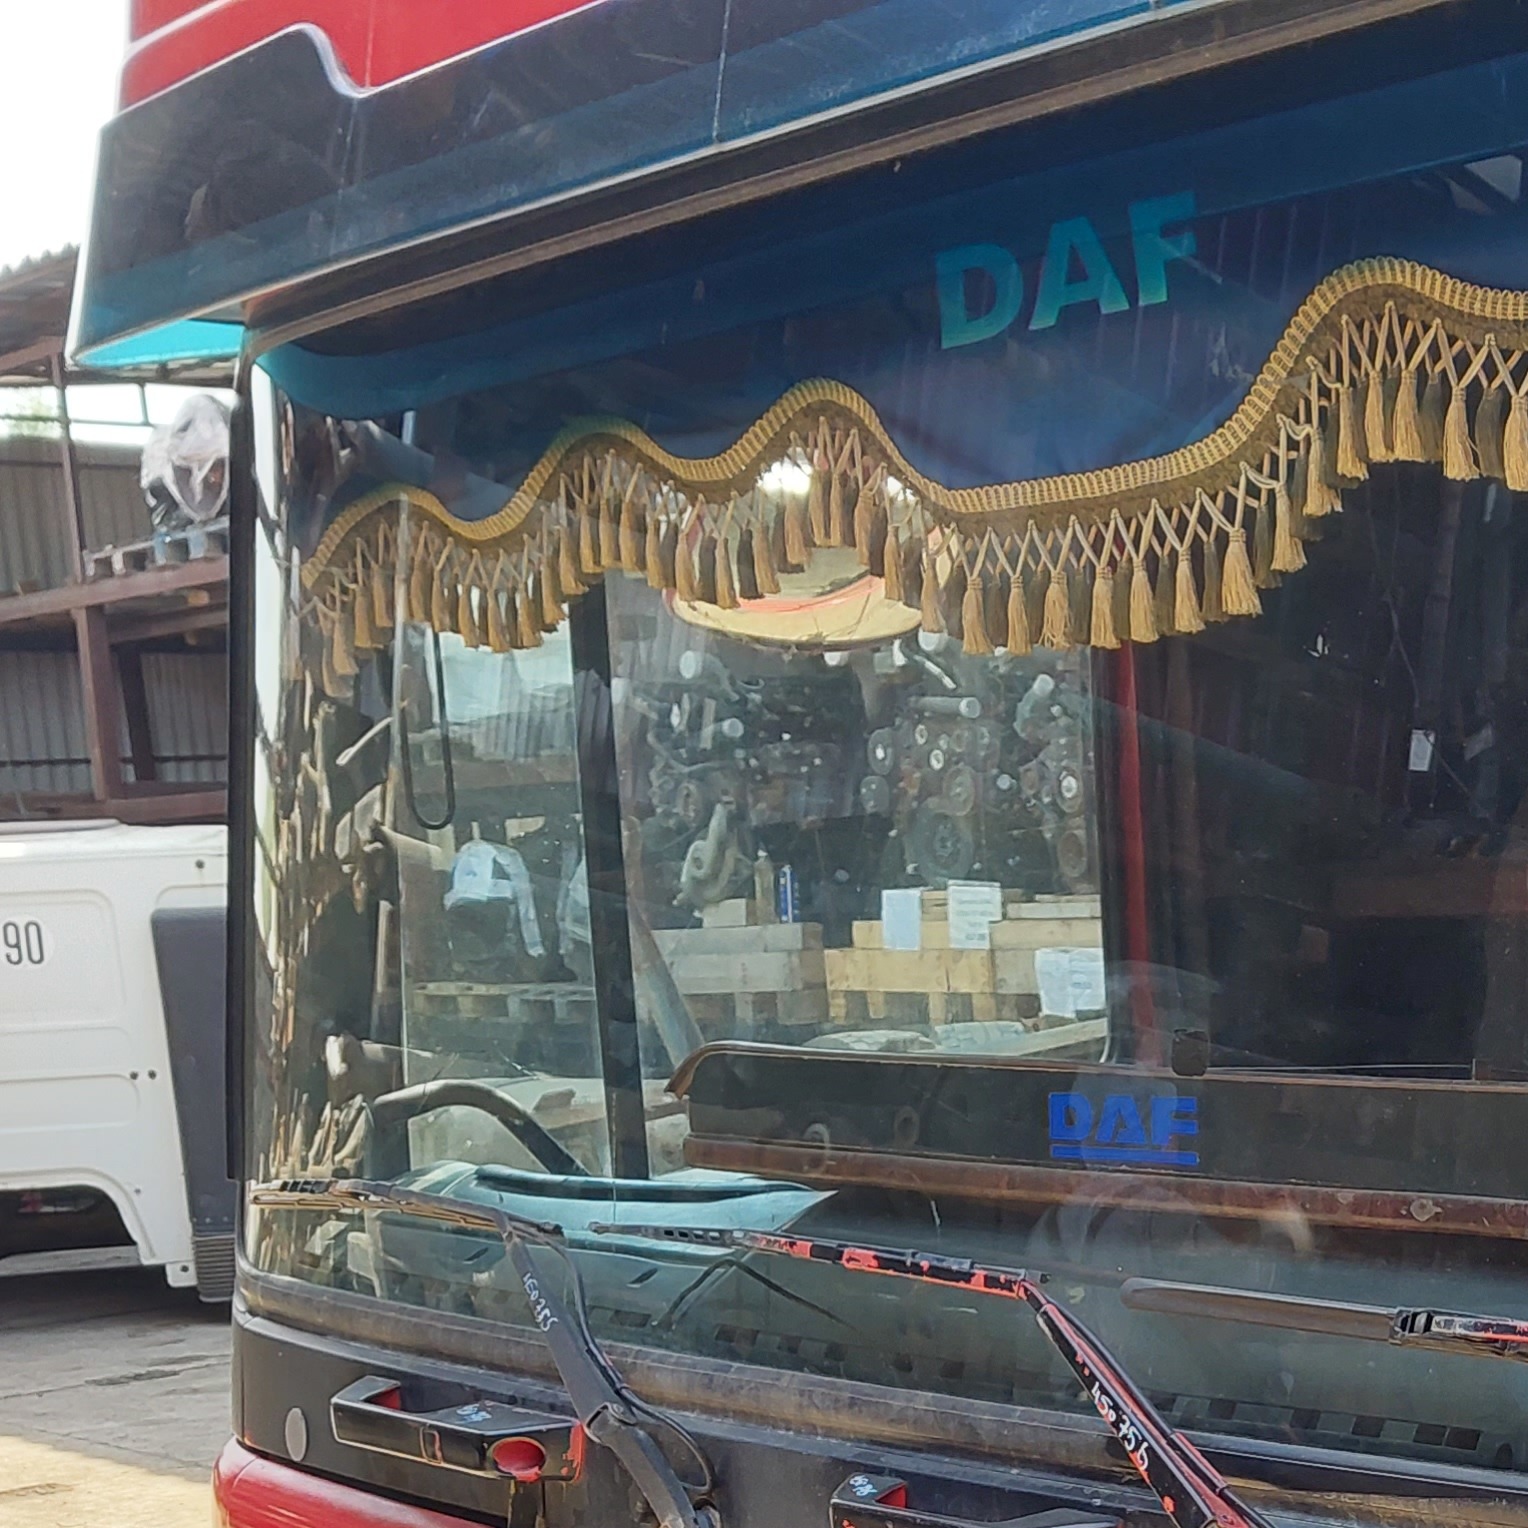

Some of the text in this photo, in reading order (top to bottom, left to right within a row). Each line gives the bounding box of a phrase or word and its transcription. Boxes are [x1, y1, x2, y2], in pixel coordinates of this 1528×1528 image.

[934, 191, 1200, 350] DAF
[2, 920, 45, 965] 90
[1048, 1092, 1199, 1146] DAF
